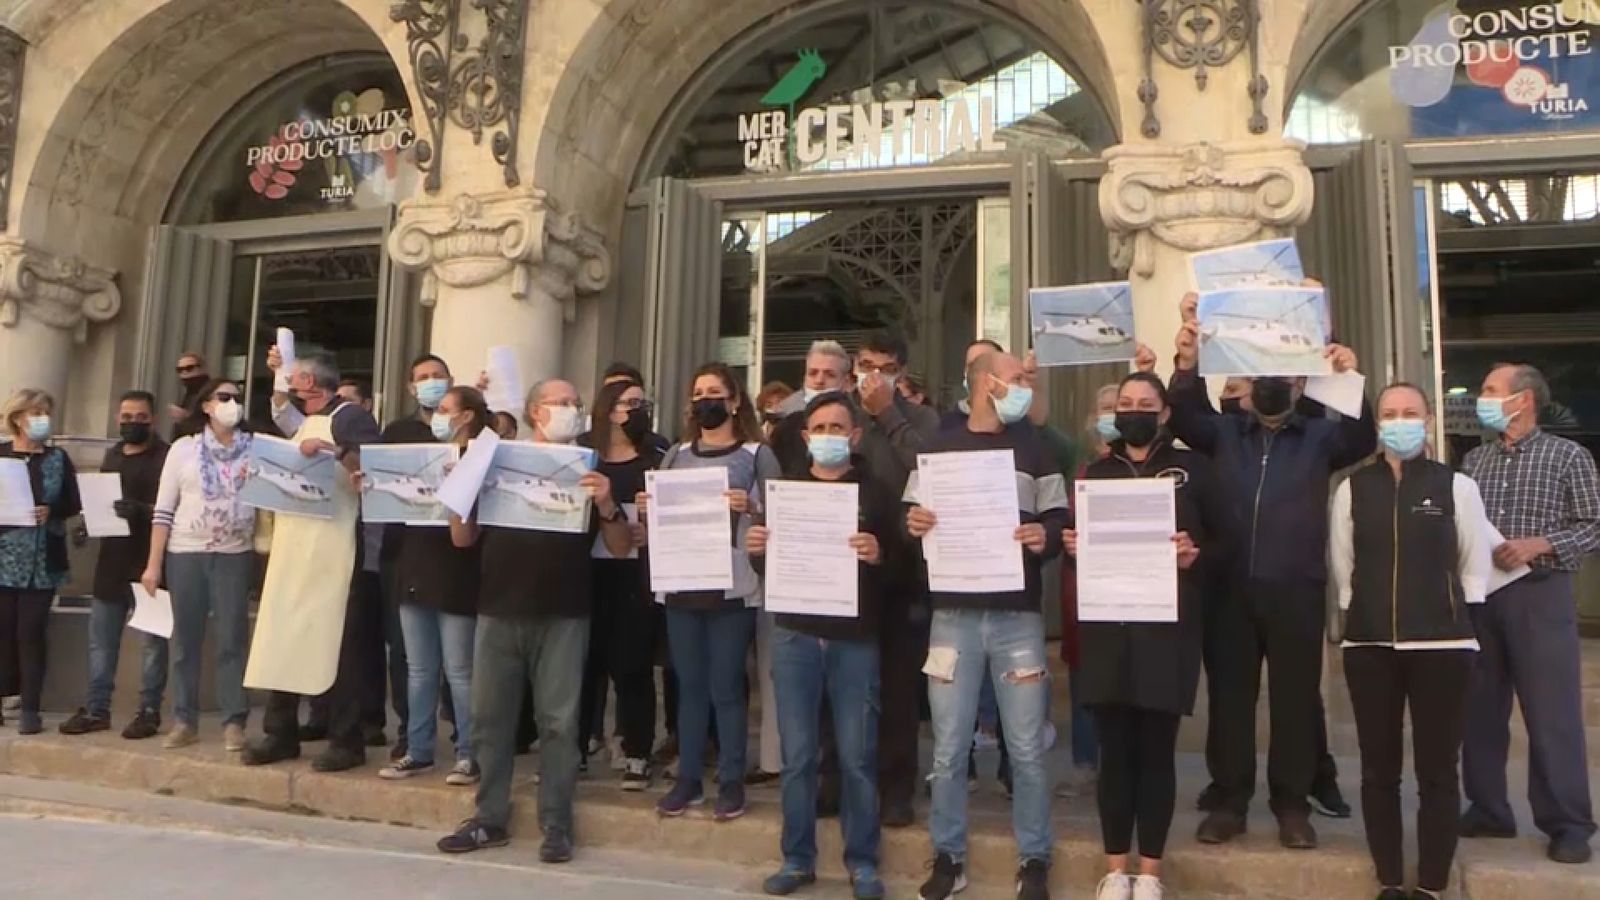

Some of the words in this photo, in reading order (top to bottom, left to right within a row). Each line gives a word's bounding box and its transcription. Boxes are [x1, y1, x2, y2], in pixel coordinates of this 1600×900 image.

[1388, 29, 1592, 69] PRODUCTE
[1529, 98, 1589, 115] TURIA
[284, 108, 408, 141] CONSUMIX
[738, 111, 786, 141] MER
[796, 95, 1007, 163] CENTRAL
[247, 134, 363, 166] PRODUCTE
[744, 138, 785, 169] CAT
